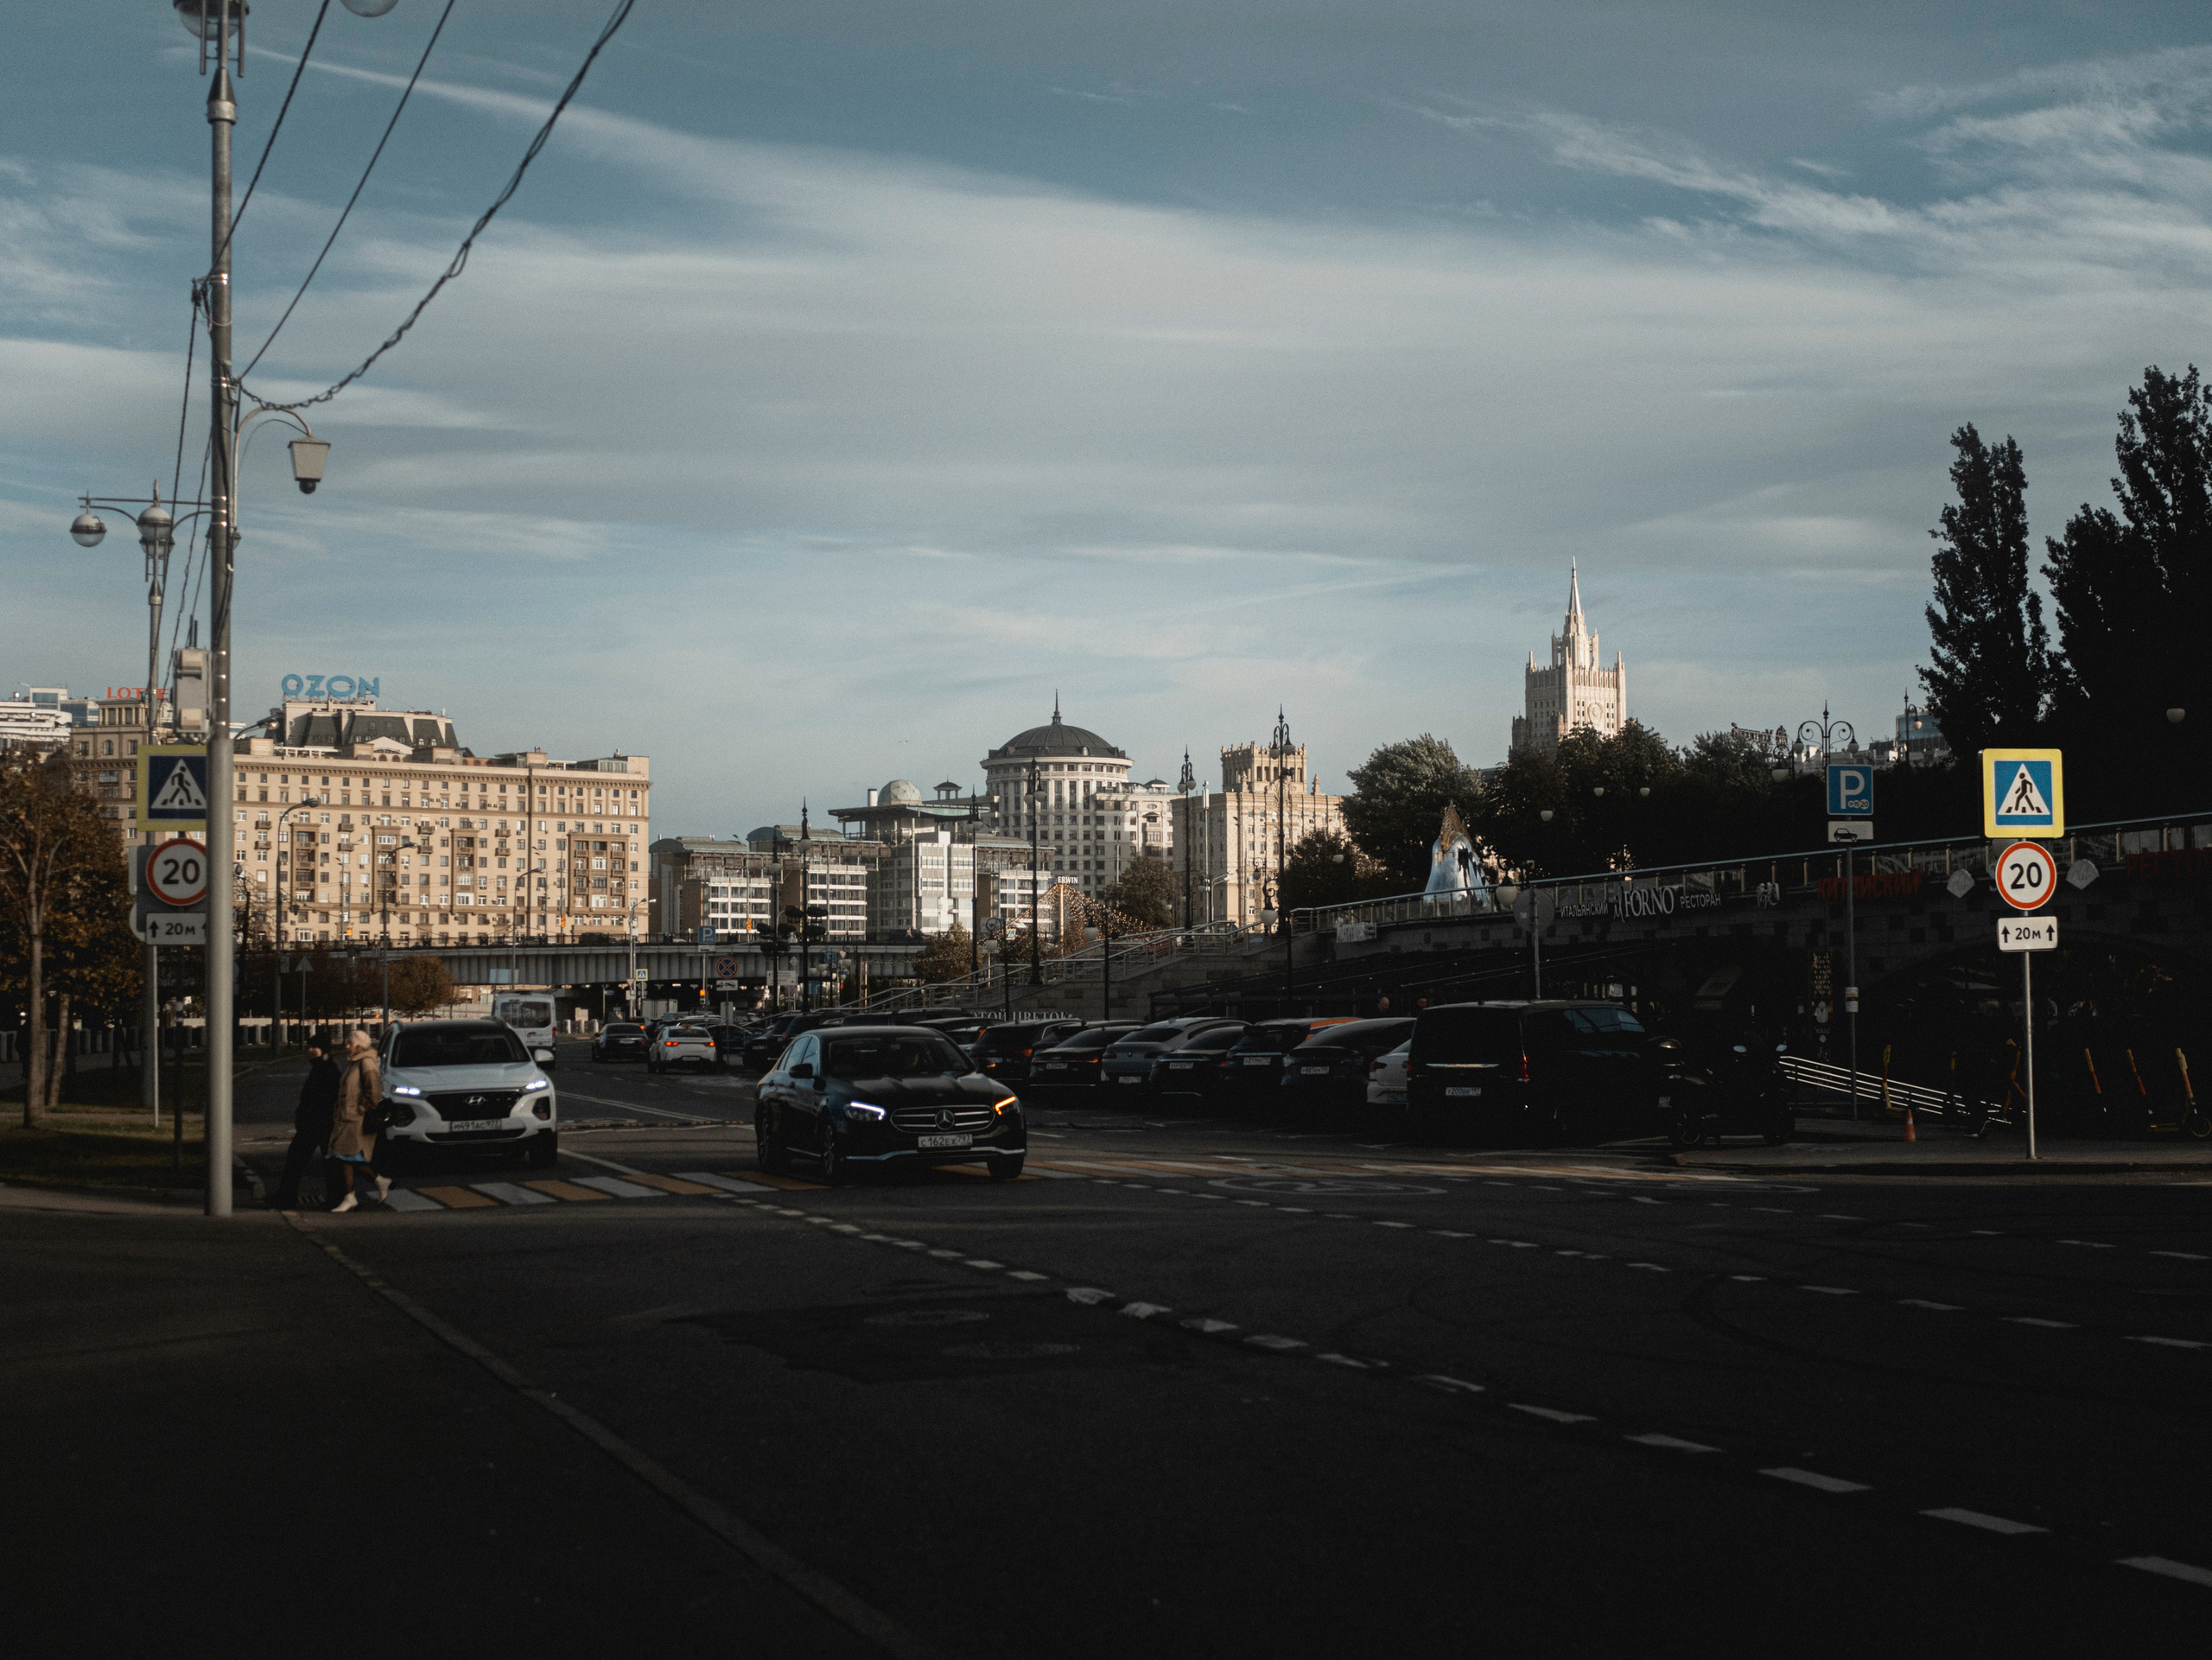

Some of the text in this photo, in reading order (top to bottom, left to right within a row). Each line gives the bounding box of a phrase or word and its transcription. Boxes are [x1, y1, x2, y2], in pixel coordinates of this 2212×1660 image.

[106, 686, 168, 700] LOTE
[281, 673, 380, 698] OZON
[162, 859, 200, 884] 20
[1058, 875, 1078, 884] ERWIN
[2010, 862, 2042, 889] 20
[1624, 887, 1675, 918] FORNO
[1680, 894, 1721, 908] РЕСТОРАН
